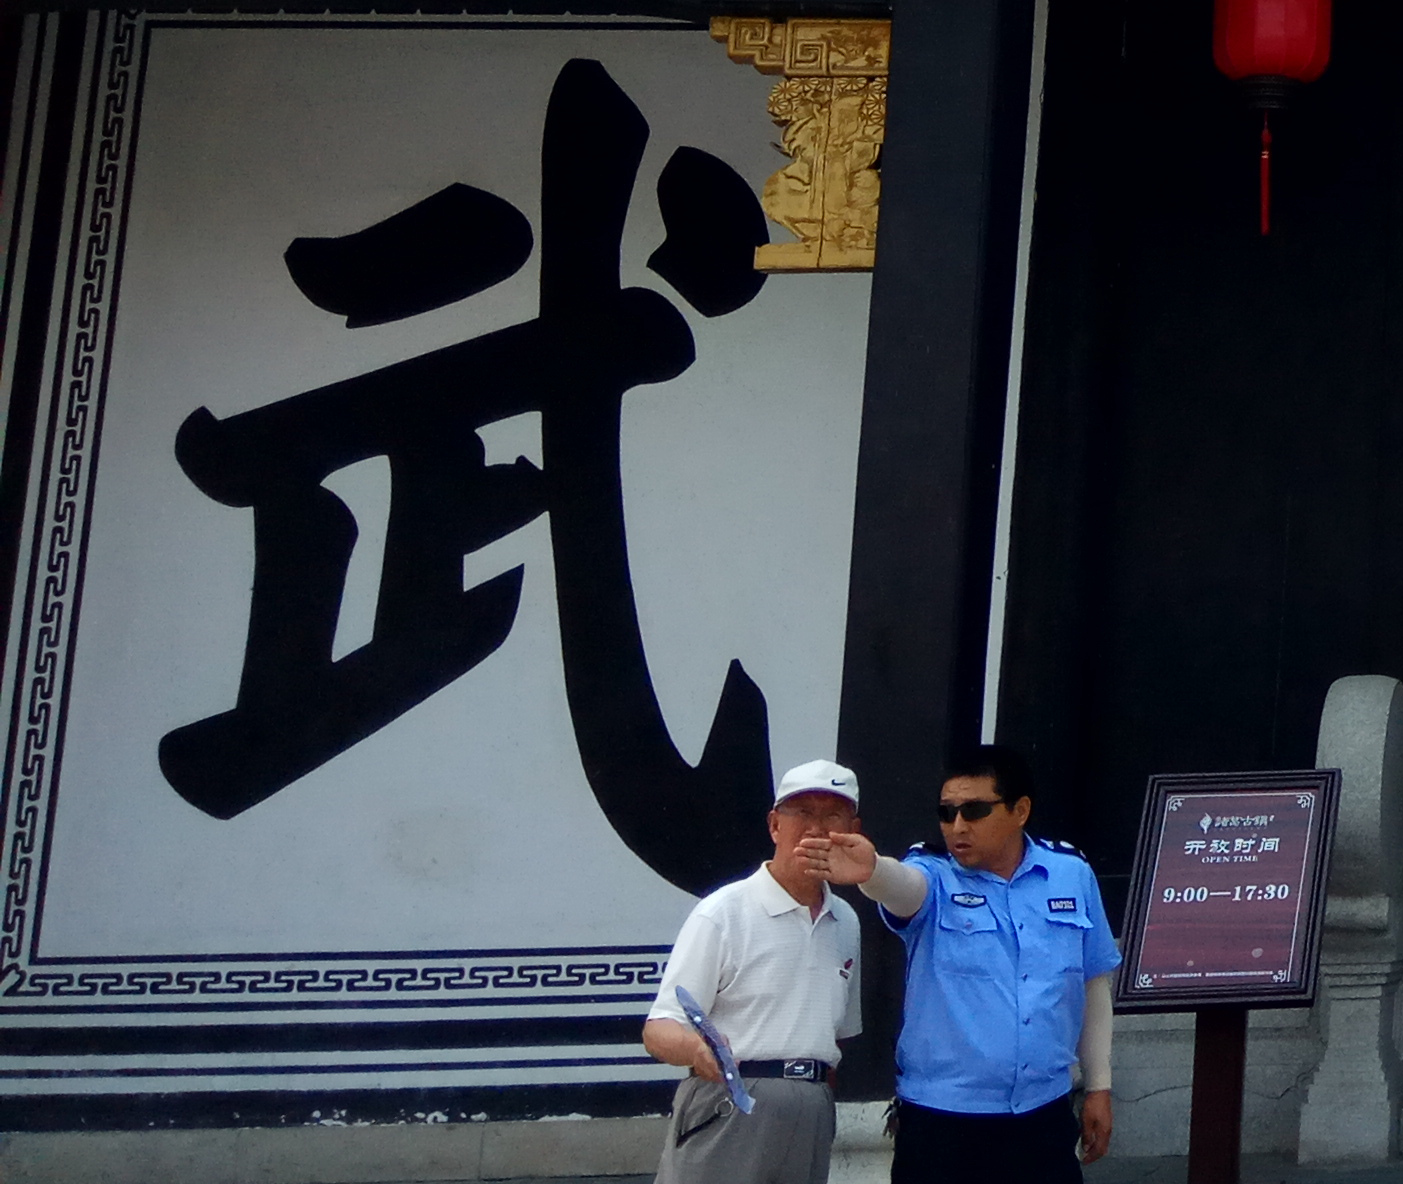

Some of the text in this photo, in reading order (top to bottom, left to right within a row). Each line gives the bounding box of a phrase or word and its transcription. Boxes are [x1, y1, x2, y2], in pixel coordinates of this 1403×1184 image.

[158, 57, 772, 901] 武
[1184, 837, 1280, 855] 开放时间
[1201, 855, 1258, 864] OPEN TIME
